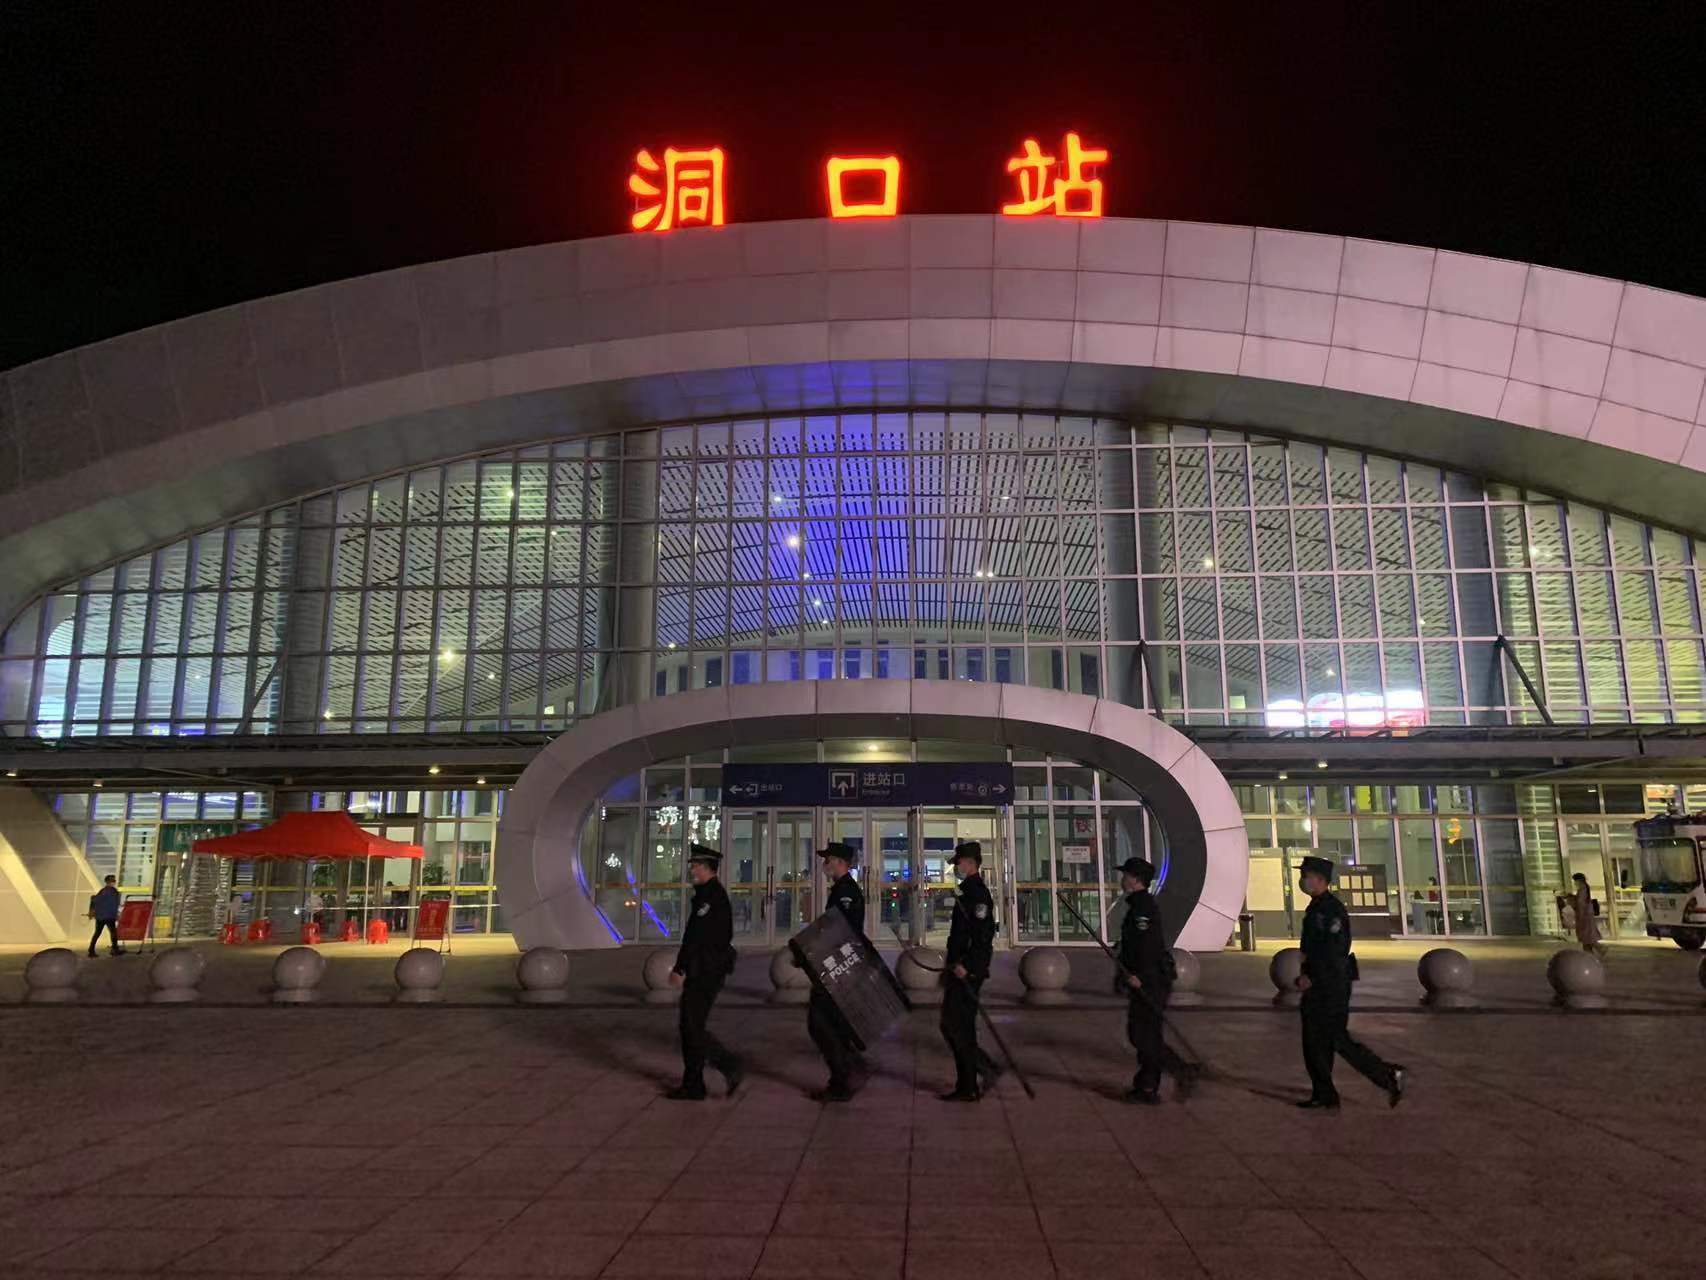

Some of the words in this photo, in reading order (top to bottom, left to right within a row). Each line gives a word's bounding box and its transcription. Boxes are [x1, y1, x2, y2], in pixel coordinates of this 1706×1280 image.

[629, 132, 1108, 231] 洞口站
[863, 772, 905, 786] 进站口
[829, 952, 860, 979] POLICE
